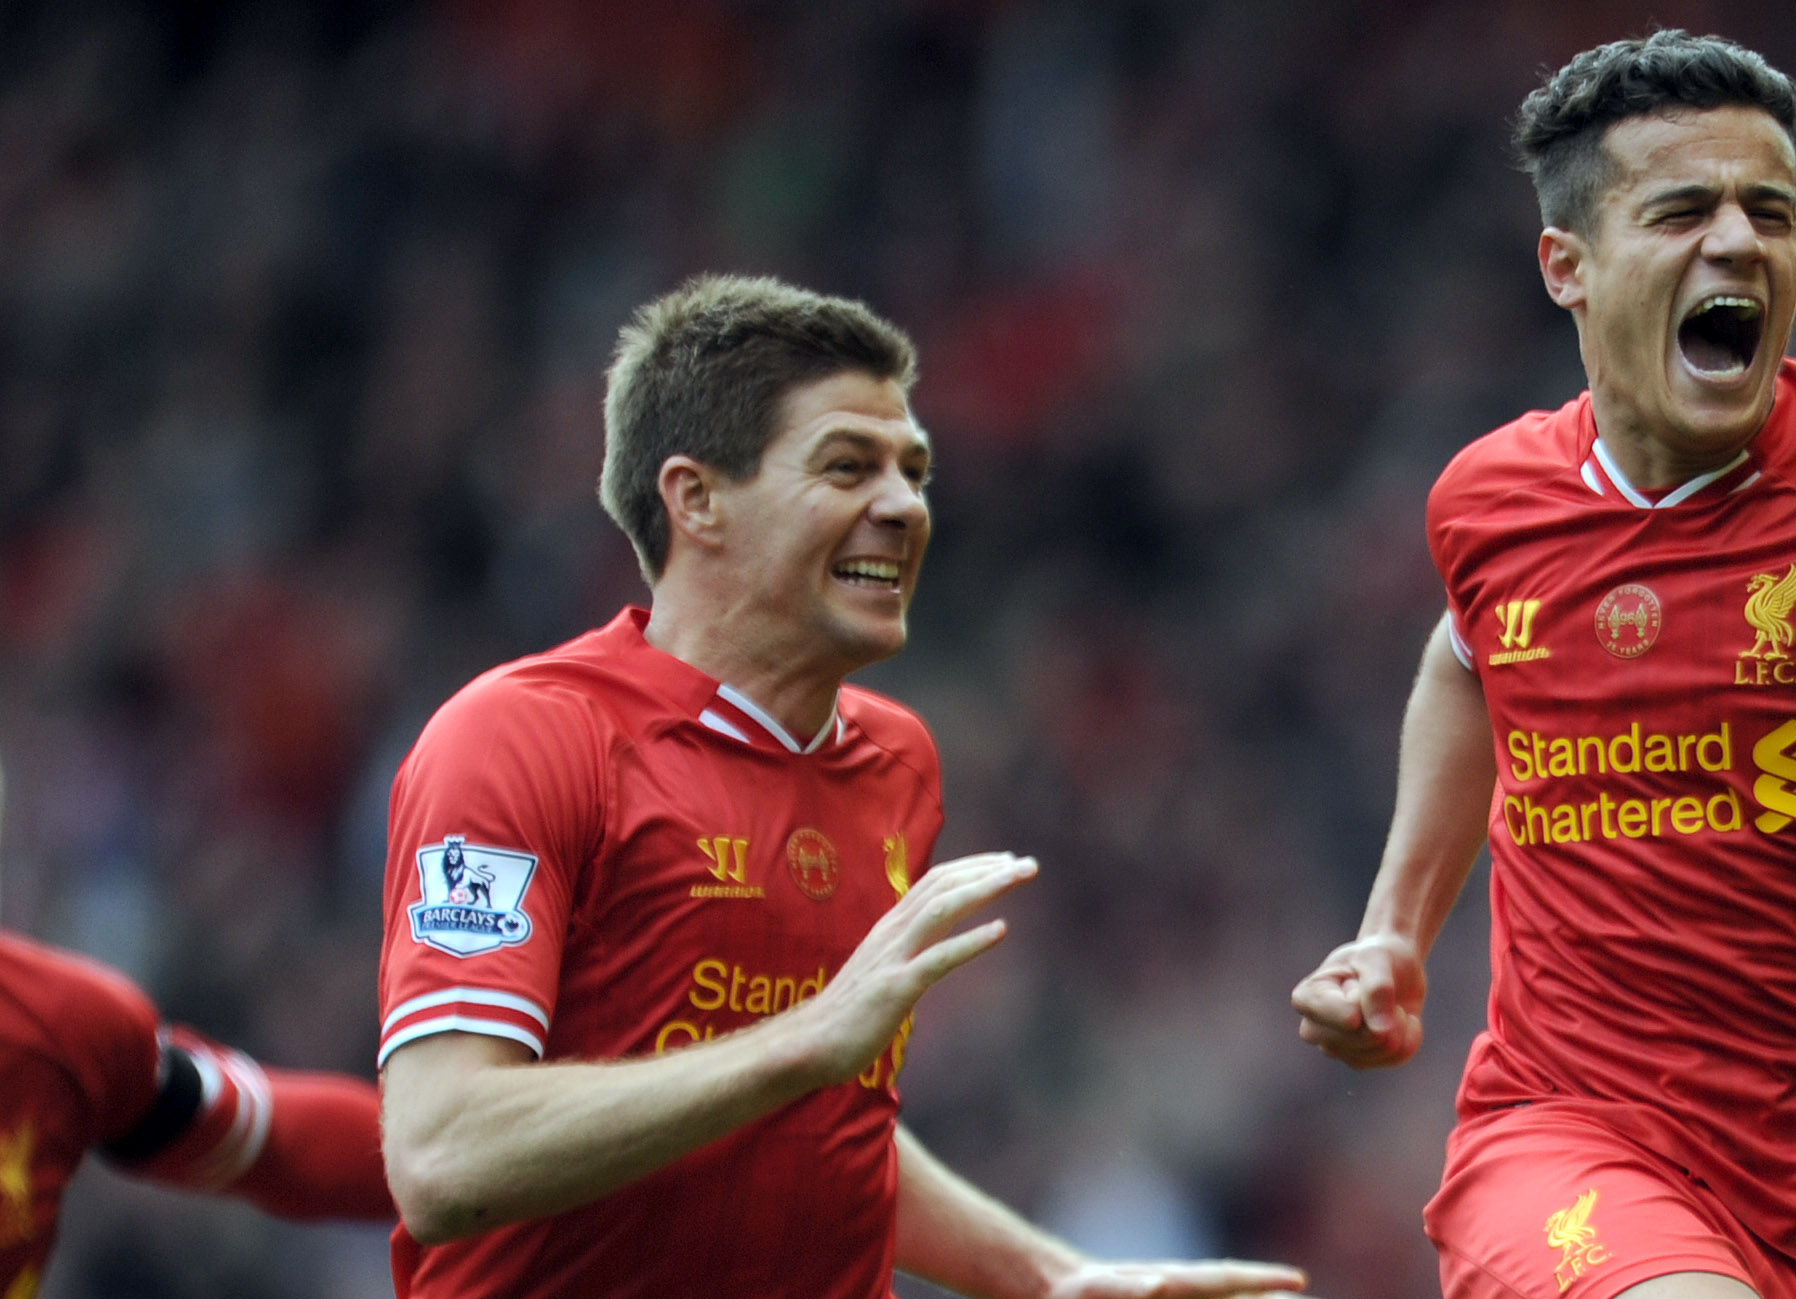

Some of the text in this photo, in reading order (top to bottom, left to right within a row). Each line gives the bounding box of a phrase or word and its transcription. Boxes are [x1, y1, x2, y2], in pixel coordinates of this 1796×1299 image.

[1507, 722, 1732, 782] Standard
[1503, 786, 1742, 846] Chartered
[424, 907, 496, 927] BARCLAYS
[689, 958, 826, 1014] Stand
